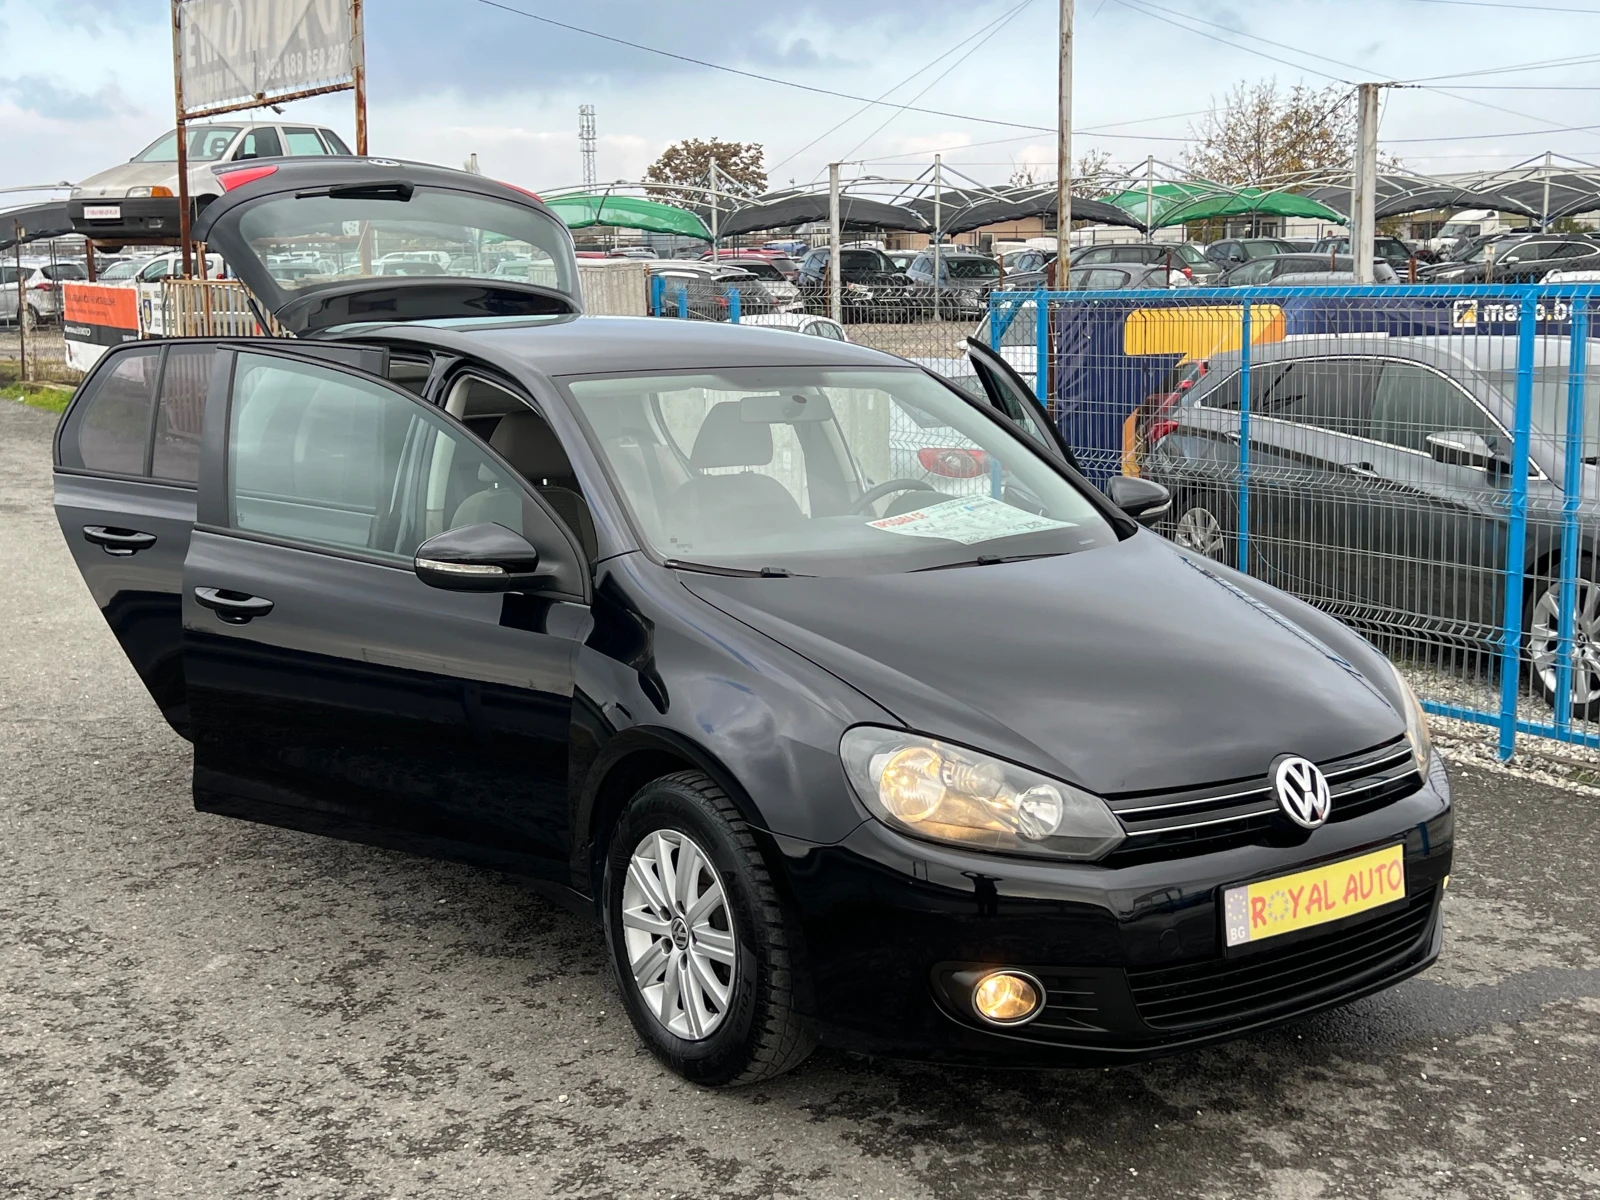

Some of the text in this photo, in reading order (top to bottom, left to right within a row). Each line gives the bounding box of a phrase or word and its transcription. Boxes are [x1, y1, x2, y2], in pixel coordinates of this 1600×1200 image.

[284, 52, 303, 77] 888
[1251, 859, 1403, 929] ROYAL AUTO
[1230, 926, 1246, 941] BG
